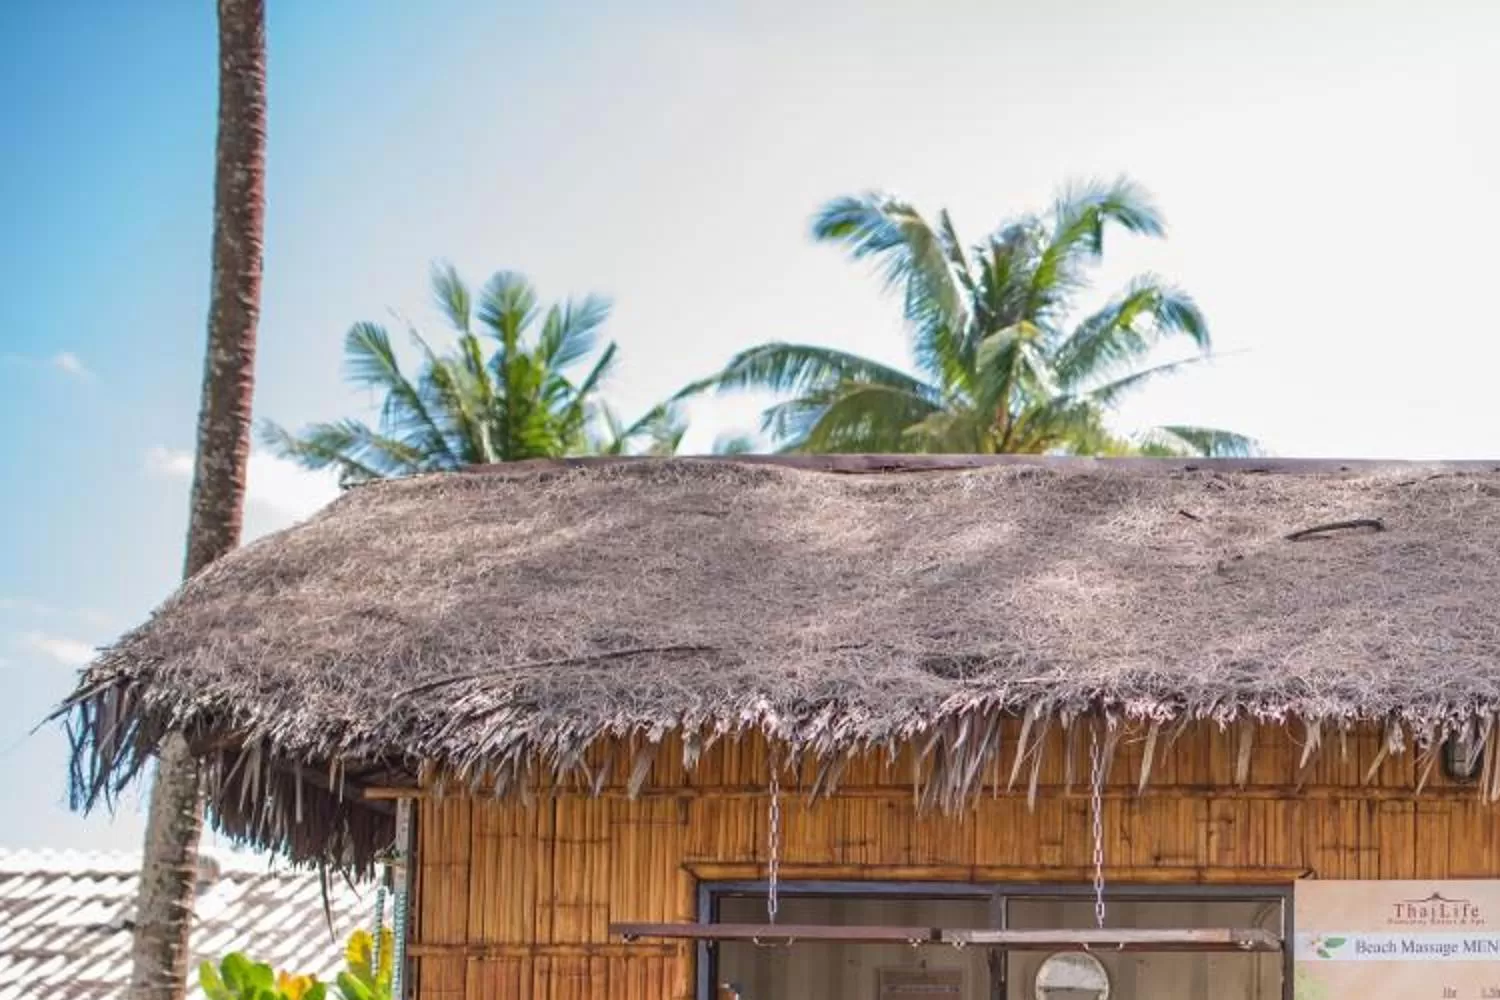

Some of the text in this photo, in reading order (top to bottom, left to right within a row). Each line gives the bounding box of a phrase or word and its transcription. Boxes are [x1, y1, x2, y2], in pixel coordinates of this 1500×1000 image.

[1392, 903, 1480, 919] ThaiLife
[1355, 938, 1397, 954] Beach
[1401, 938, 1459, 957] Massage
